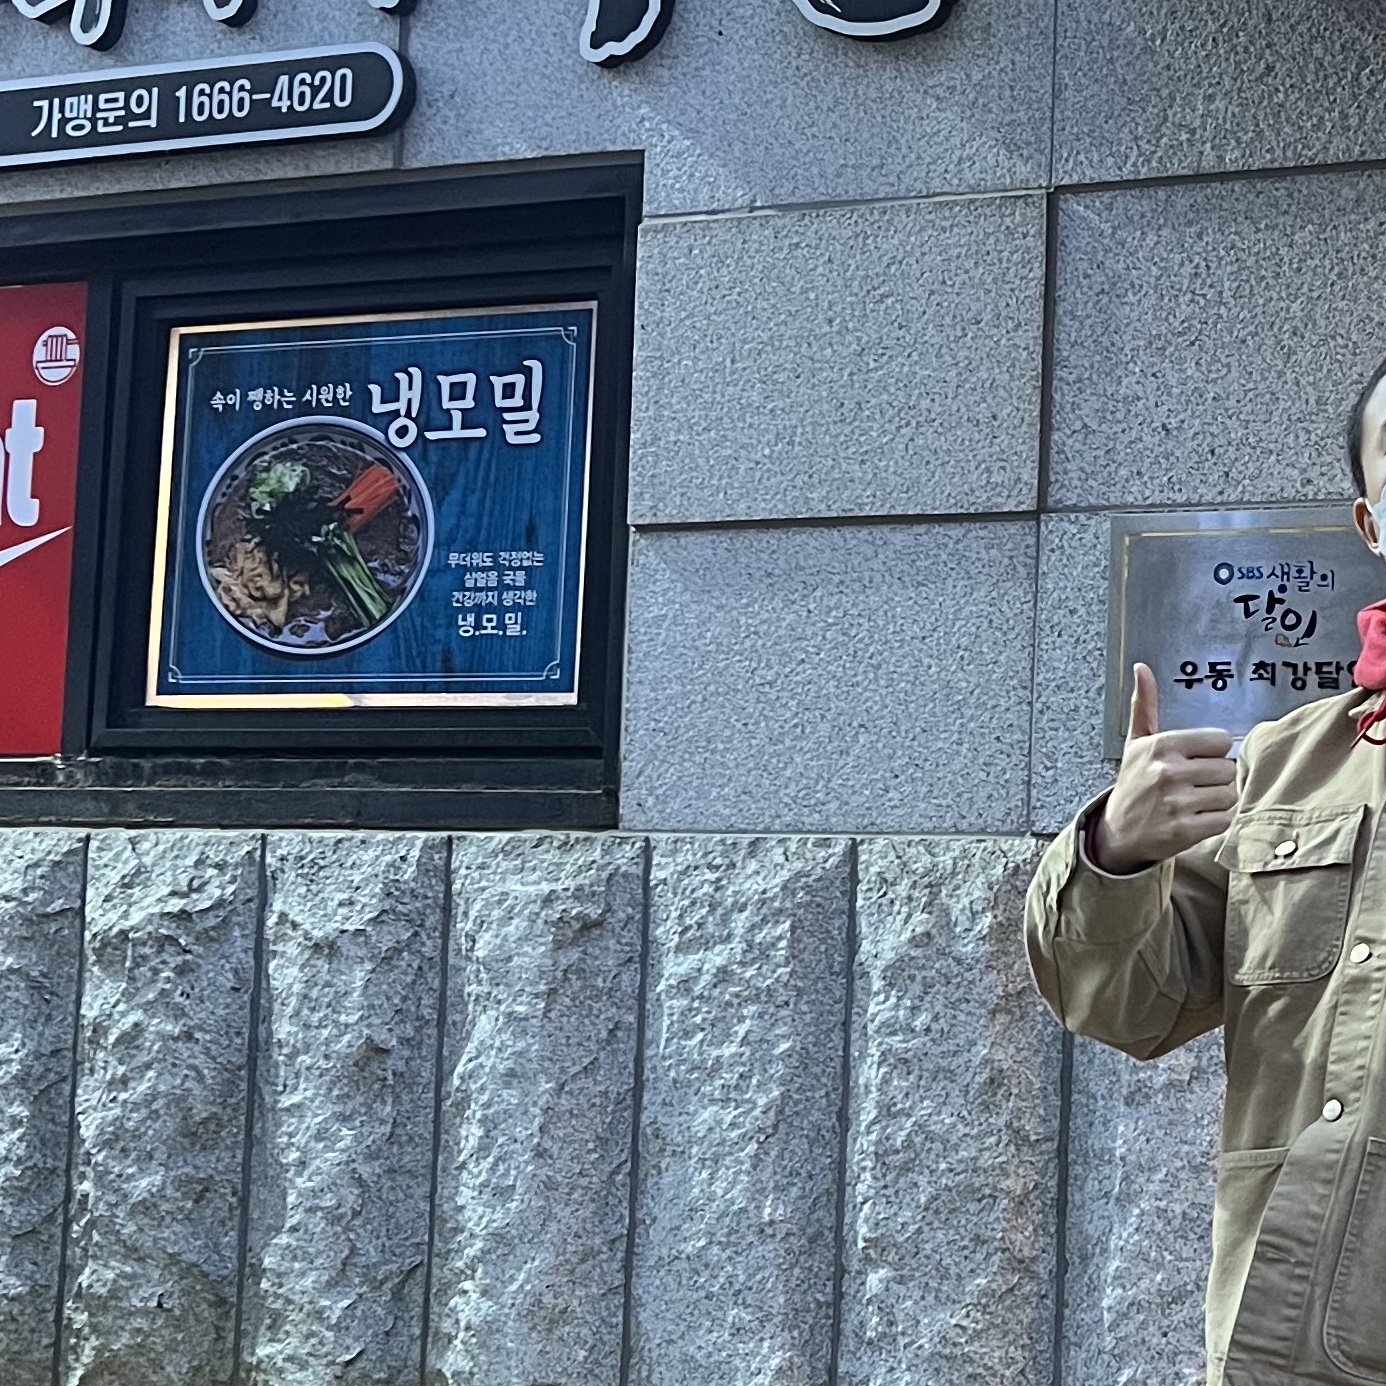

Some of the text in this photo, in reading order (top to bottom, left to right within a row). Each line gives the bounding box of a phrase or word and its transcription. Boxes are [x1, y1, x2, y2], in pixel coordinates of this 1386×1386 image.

[32, 67, 354, 138] 가맹문의 1666-4620
[210, 388, 241, 412] 속이
[302, 382, 353, 408] 시원한
[367, 359, 543, 448] 냉모밀
[447, 551, 546, 568] 무더위도 걱정없는
[1237, 561, 1335, 594] SBS 생활의
[1233, 590, 1317, 648] 달인
[1173, 660, 1358, 691] 우동 최강달
